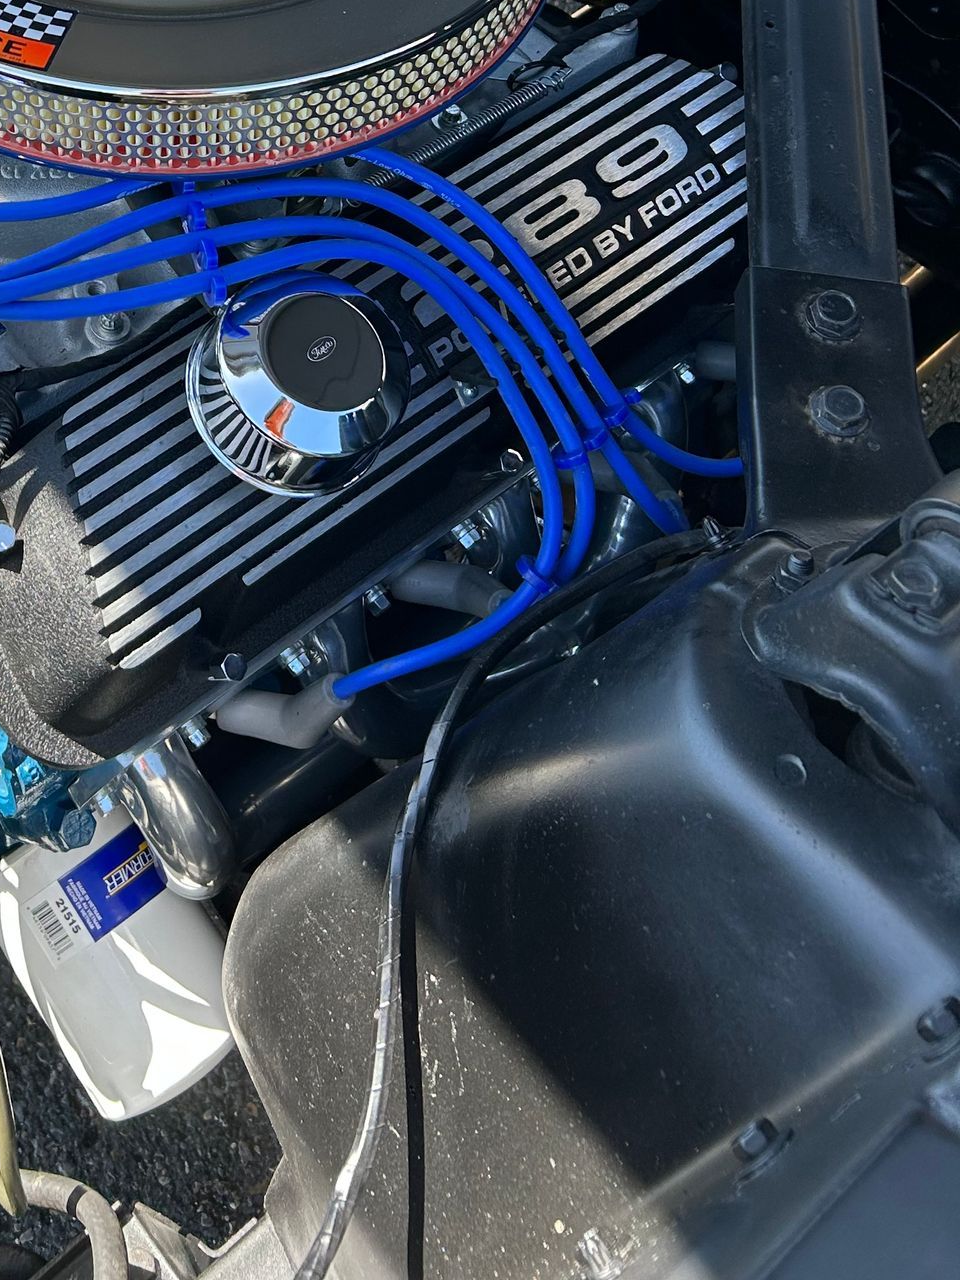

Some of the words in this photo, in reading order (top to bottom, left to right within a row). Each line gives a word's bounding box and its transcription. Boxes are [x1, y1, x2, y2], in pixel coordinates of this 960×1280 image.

[427, 245, 593, 369] POED
[592, 215, 641, 260] BY
[638, 162, 722, 229] FORD
[55, 897, 82, 934] 21515
